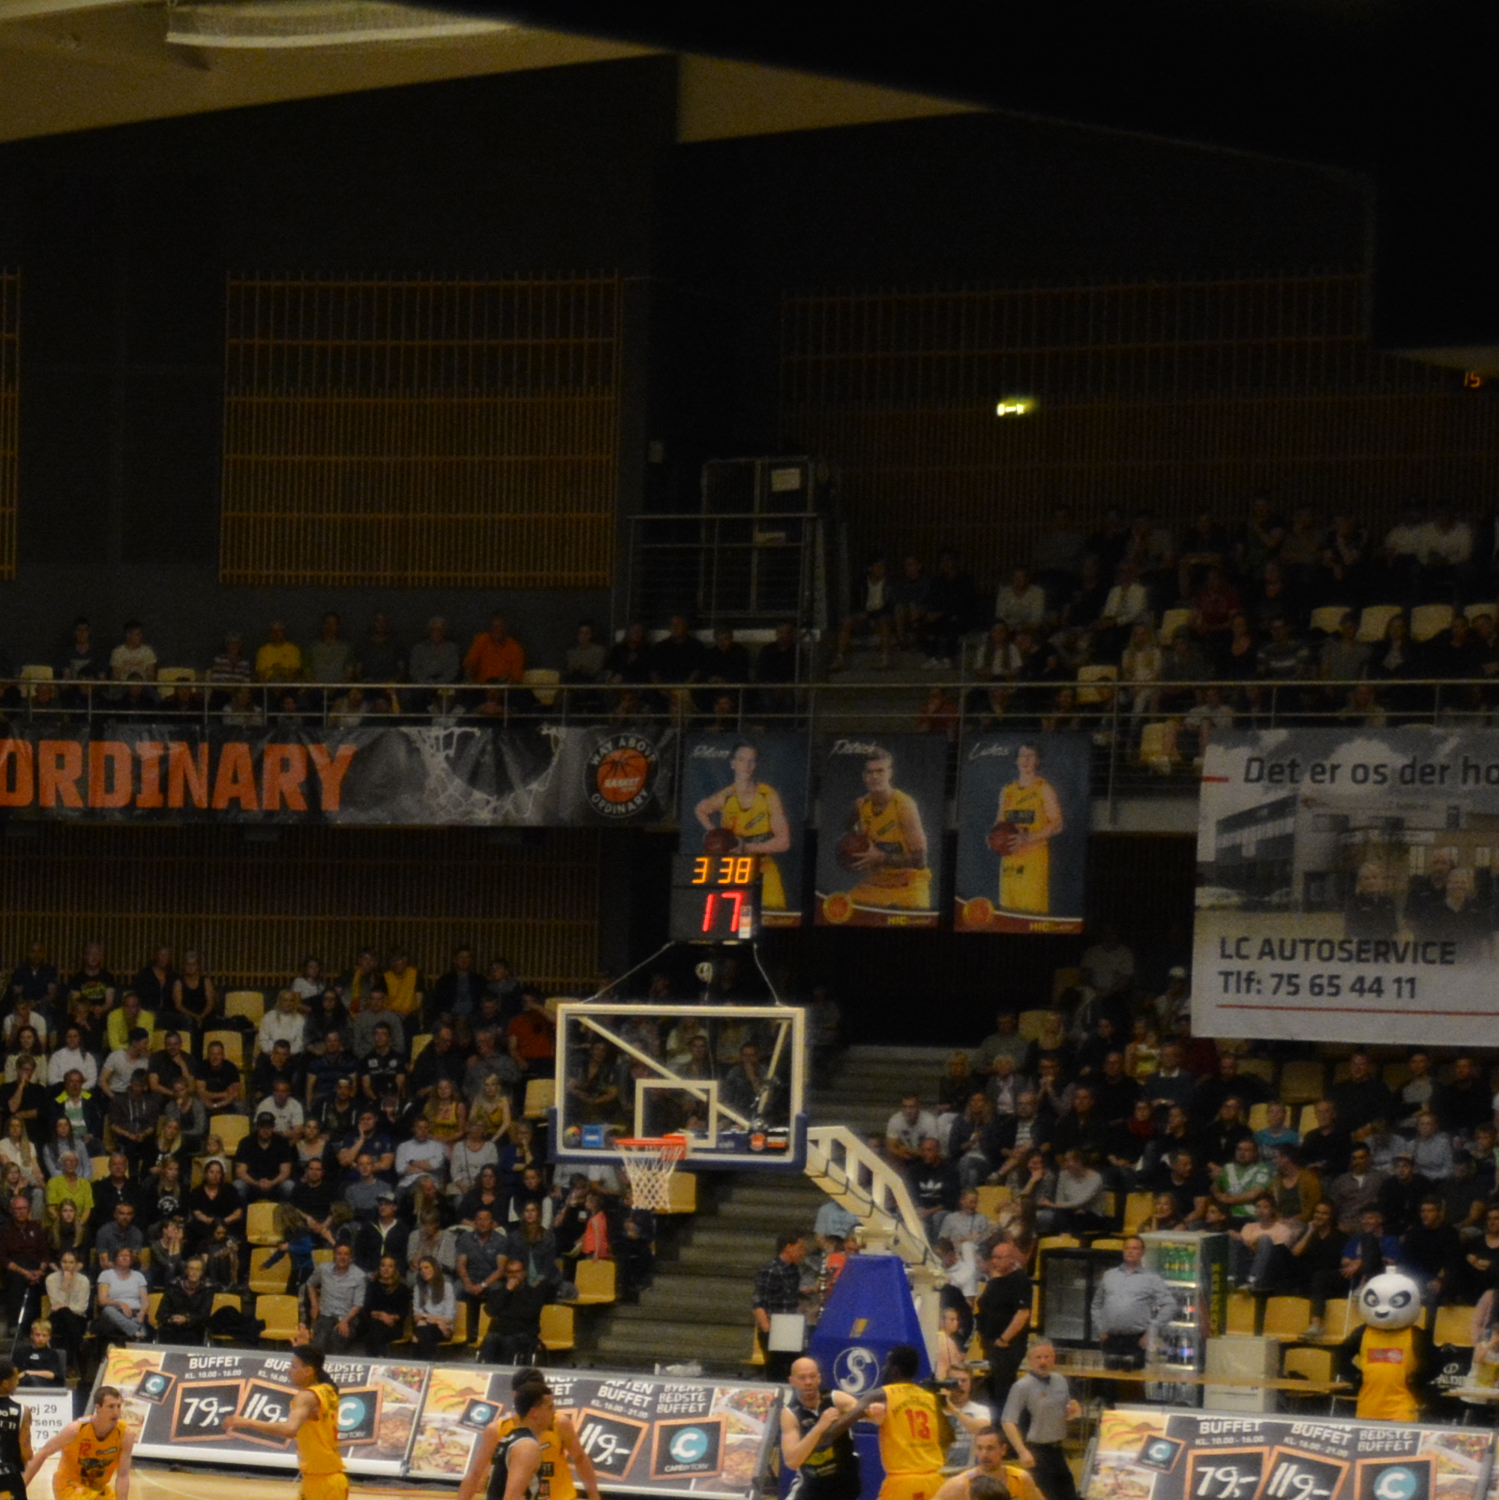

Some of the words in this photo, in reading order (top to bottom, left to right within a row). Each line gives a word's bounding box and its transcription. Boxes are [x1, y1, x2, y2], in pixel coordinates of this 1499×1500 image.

[1243, 757, 1301, 784] Det
[1309, 763, 1341, 784] er
[1350, 763, 1388, 785] os
[1399, 756, 1451, 785] der
[717, 857, 752, 884] 38
[702, 892, 742, 932] 17
[1220, 937, 1251, 960] LC
[1257, 938, 1456, 965] AUTOSERVICE
[1218, 971, 1262, 994] Tlf:
[1270, 973, 1300, 996] 75
[1309, 975, 1341, 997] 65
[1349, 976, 1384, 998] 44
[1393, 977, 1417, 999] 11
[189, 1357, 241, 1370] BUFFET
[264, 1358, 291, 1371] BUF
[44, 1404, 57, 1414] 29
[597, 1385, 652, 1408] BUFFET
[658, 1391, 706, 1404] BEDSTE
[656, 1402, 706, 1414] BUFFET
[905, 1408, 931, 1440] 13
[1199, 1420, 1262, 1435] BUFFET
[1291, 1422, 1352, 1446] BUFFET
[1360, 1429, 1414, 1441] BEDSTE
[1357, 1440, 1413, 1452] BUFFET
